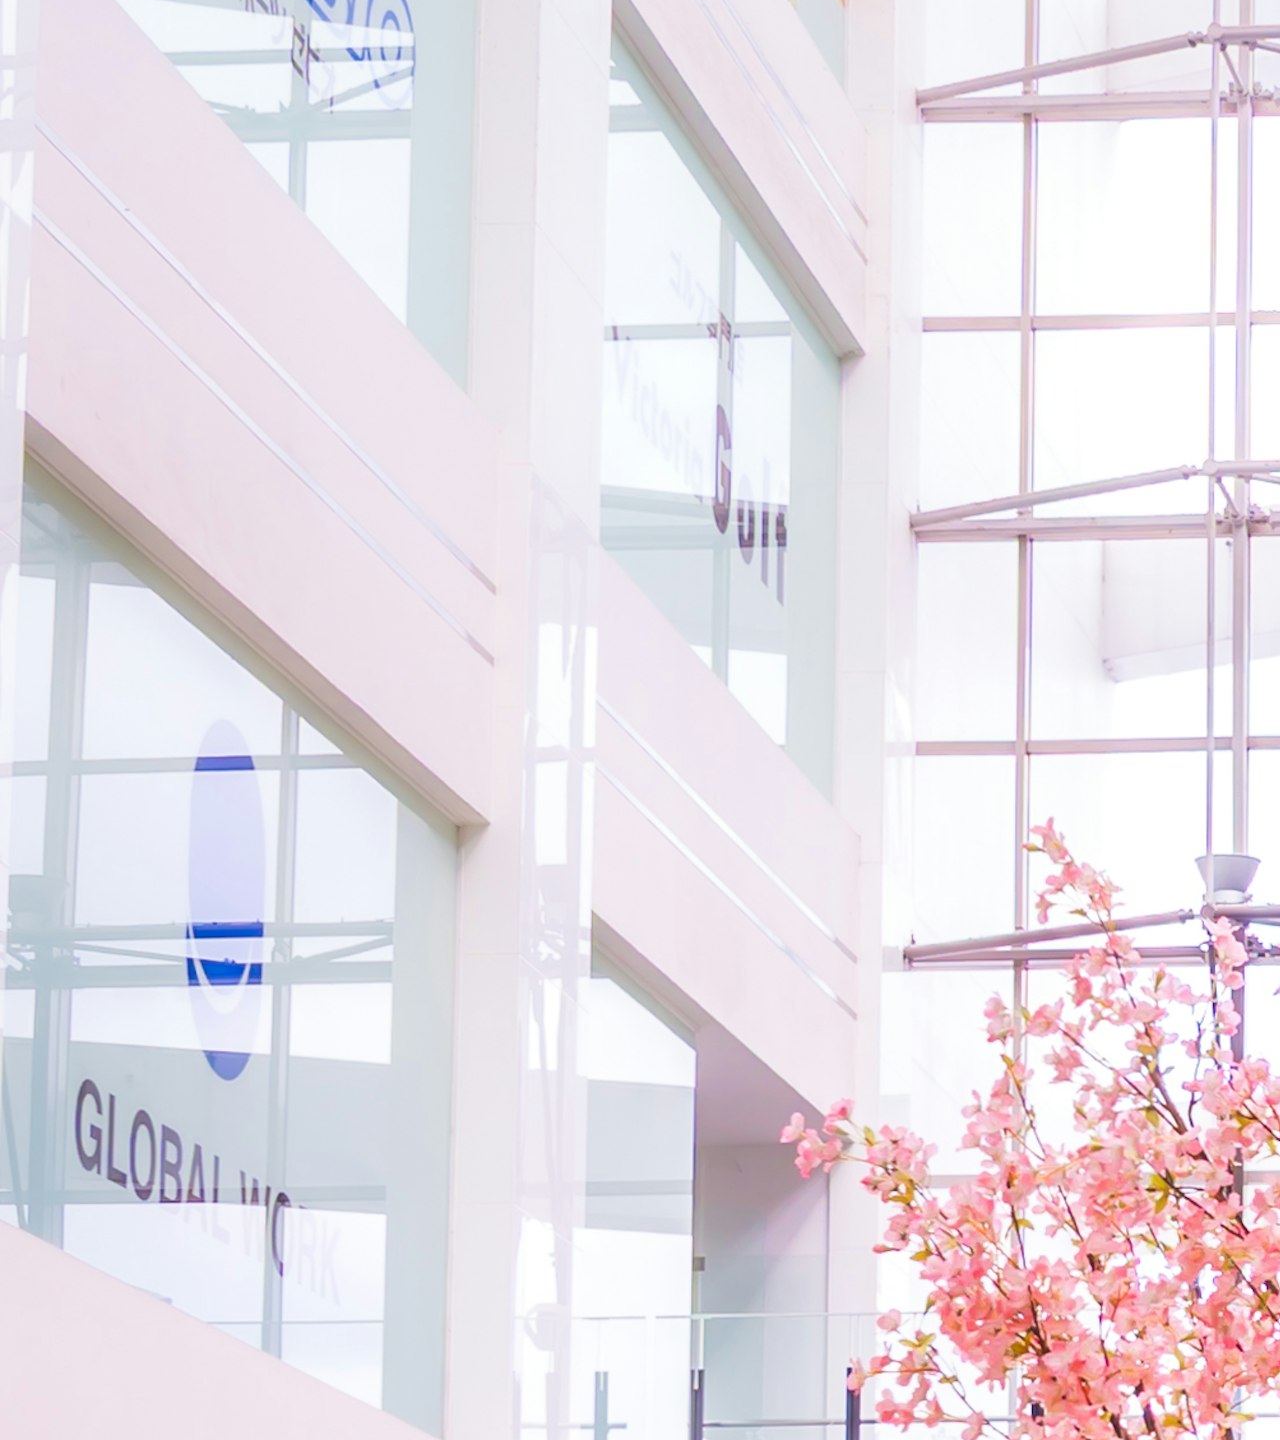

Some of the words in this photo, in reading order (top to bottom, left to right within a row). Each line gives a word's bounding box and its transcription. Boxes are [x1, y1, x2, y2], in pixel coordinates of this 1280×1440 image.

[611, 315, 705, 507] Victoria
[711, 403, 787, 608] Golf
[74, 1077, 231, 1247] GLOBAL
[238, 1168, 342, 1308] WORK
